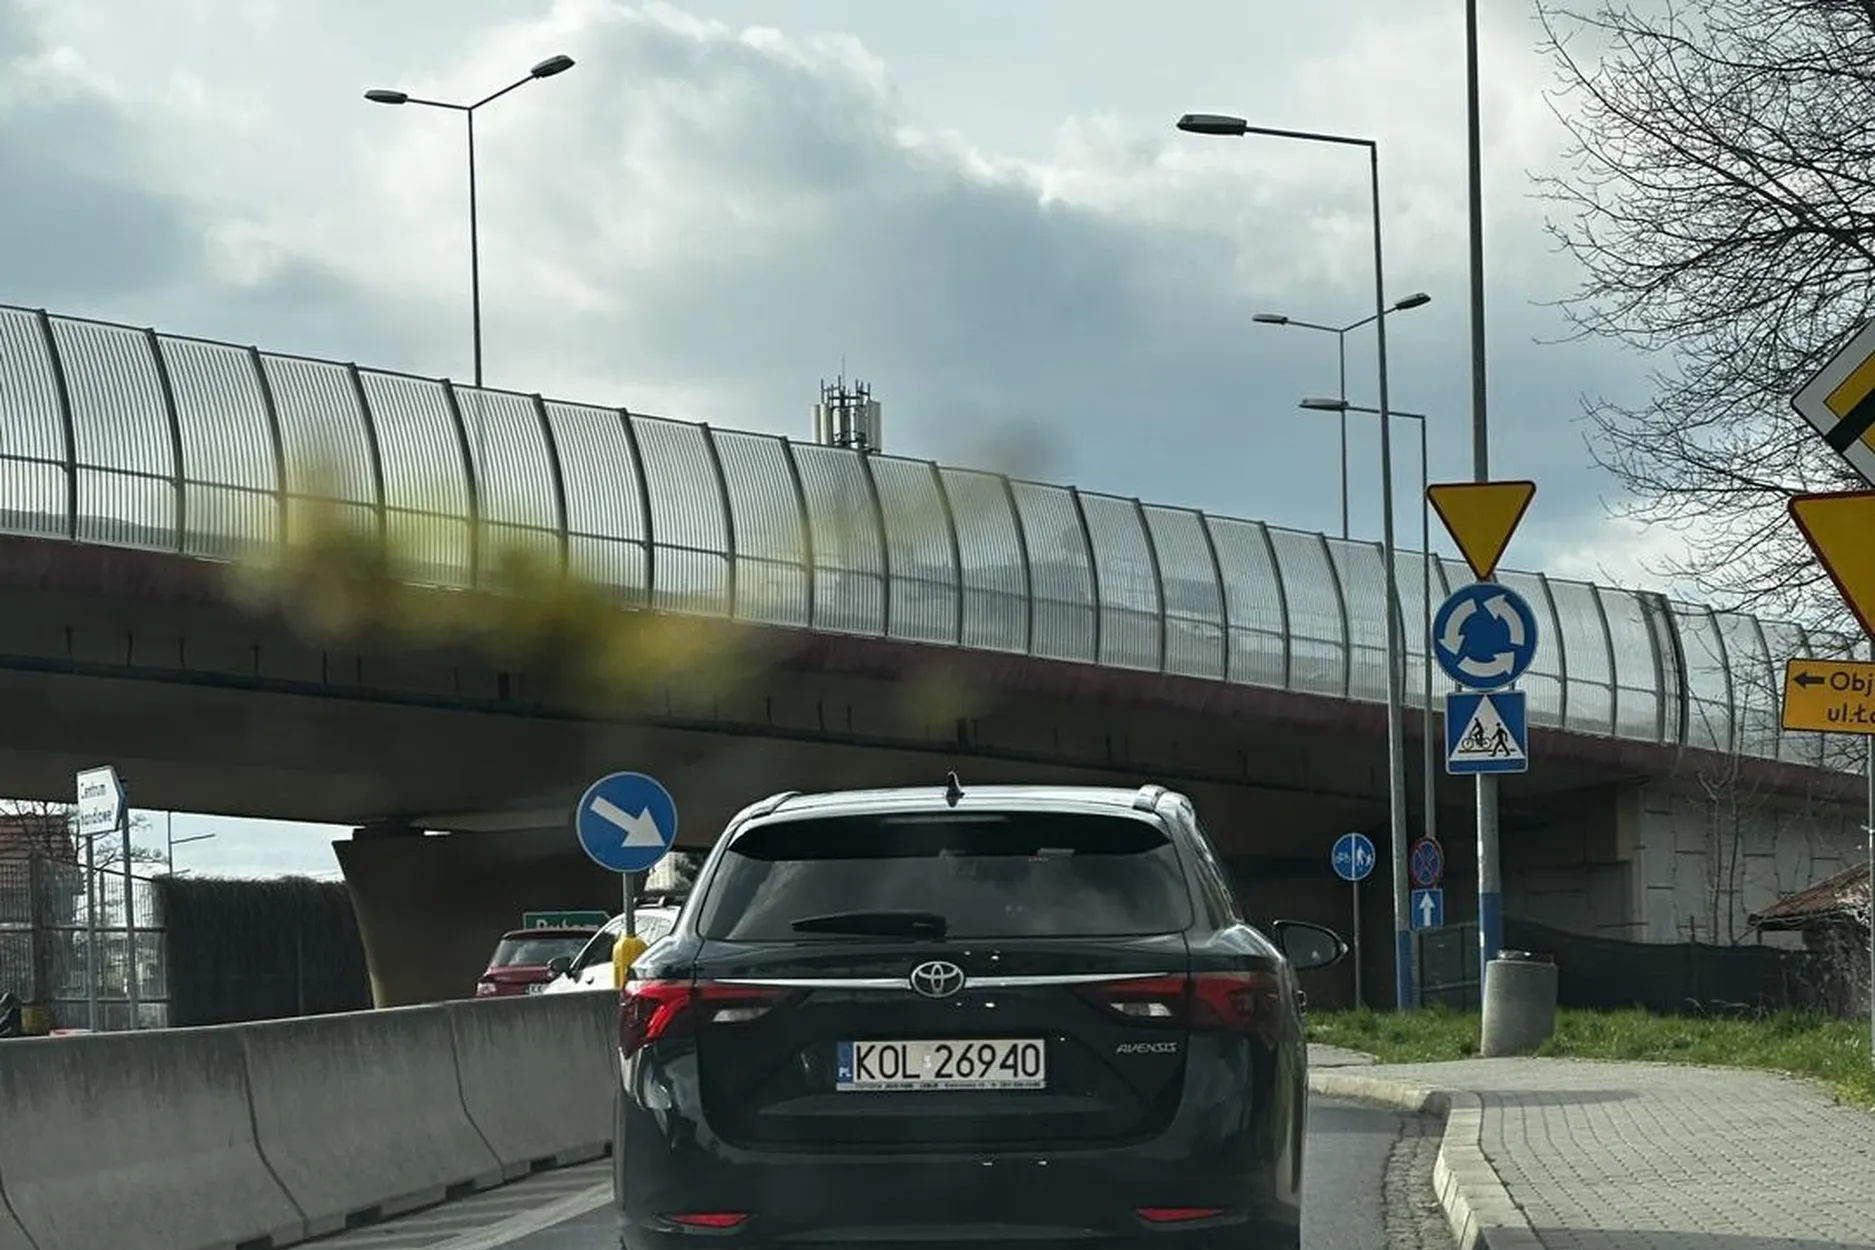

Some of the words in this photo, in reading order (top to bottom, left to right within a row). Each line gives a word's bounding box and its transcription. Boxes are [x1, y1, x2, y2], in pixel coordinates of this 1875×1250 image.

[1830, 671, 1873, 697] Obj
[1116, 1042, 1178, 1054] AVENSIS
[856, 1044, 921, 1080] KOL
[934, 1043, 1041, 1079] 26940
[838, 1066, 852, 1077] PL
